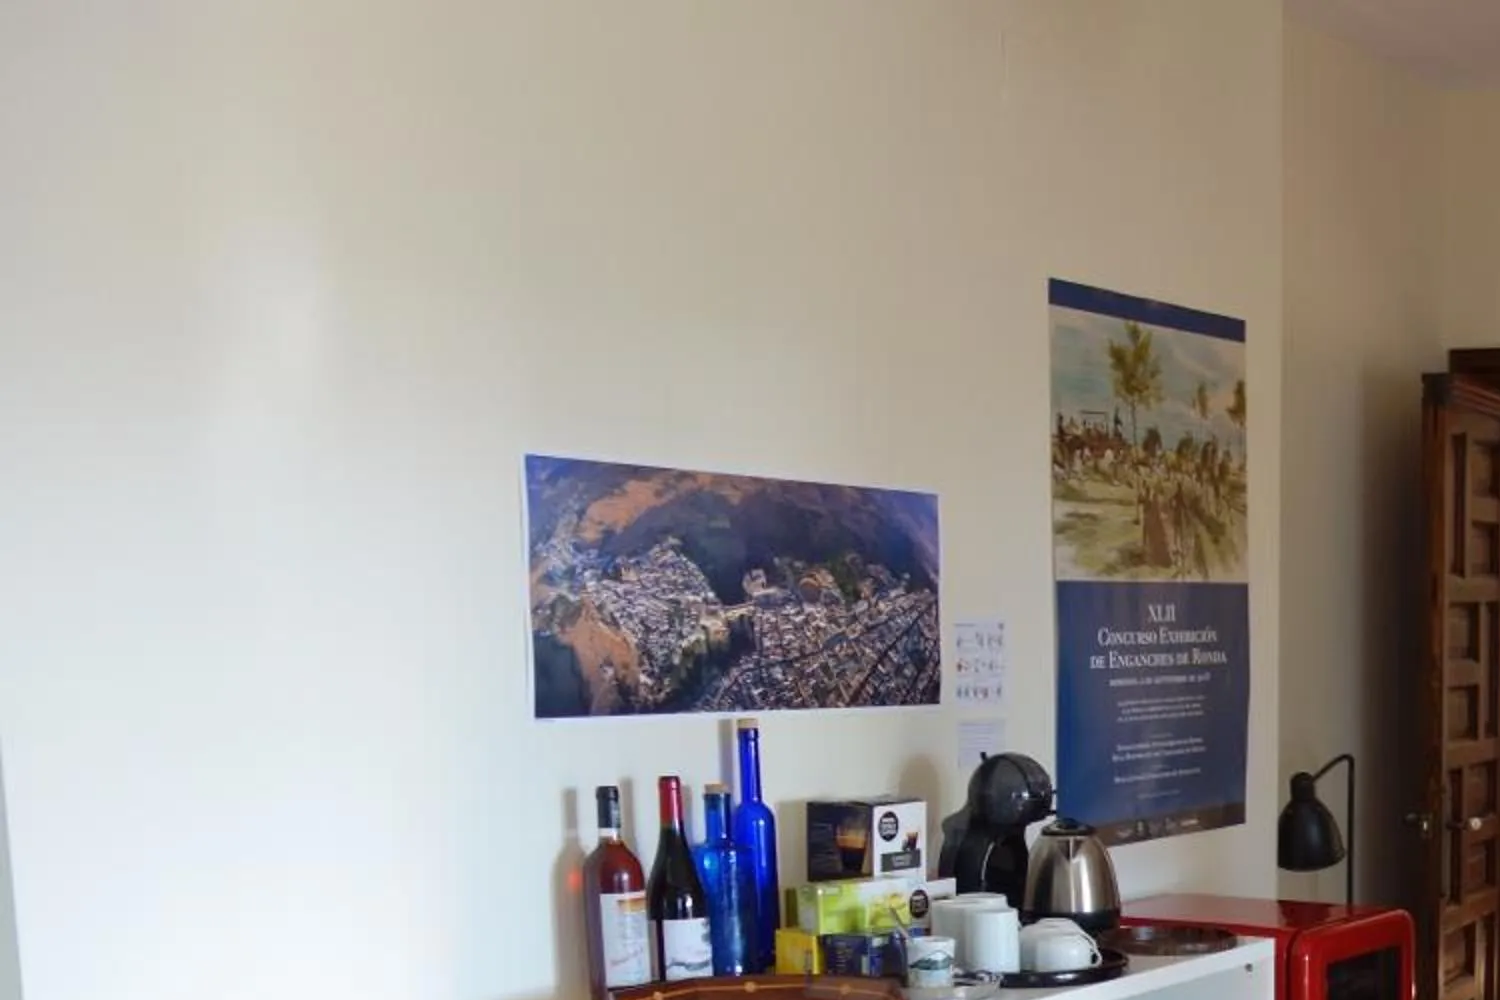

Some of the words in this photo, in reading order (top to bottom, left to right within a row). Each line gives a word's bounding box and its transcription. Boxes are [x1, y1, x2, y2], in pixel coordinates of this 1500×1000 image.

[1148, 604, 1176, 623] XLII
[1097, 627, 1157, 647] CONCURSO
[1089, 656, 1105, 669] DE
[1109, 650, 1174, 669] ENGANCHES
[1191, 647, 1228, 665] RONDA
